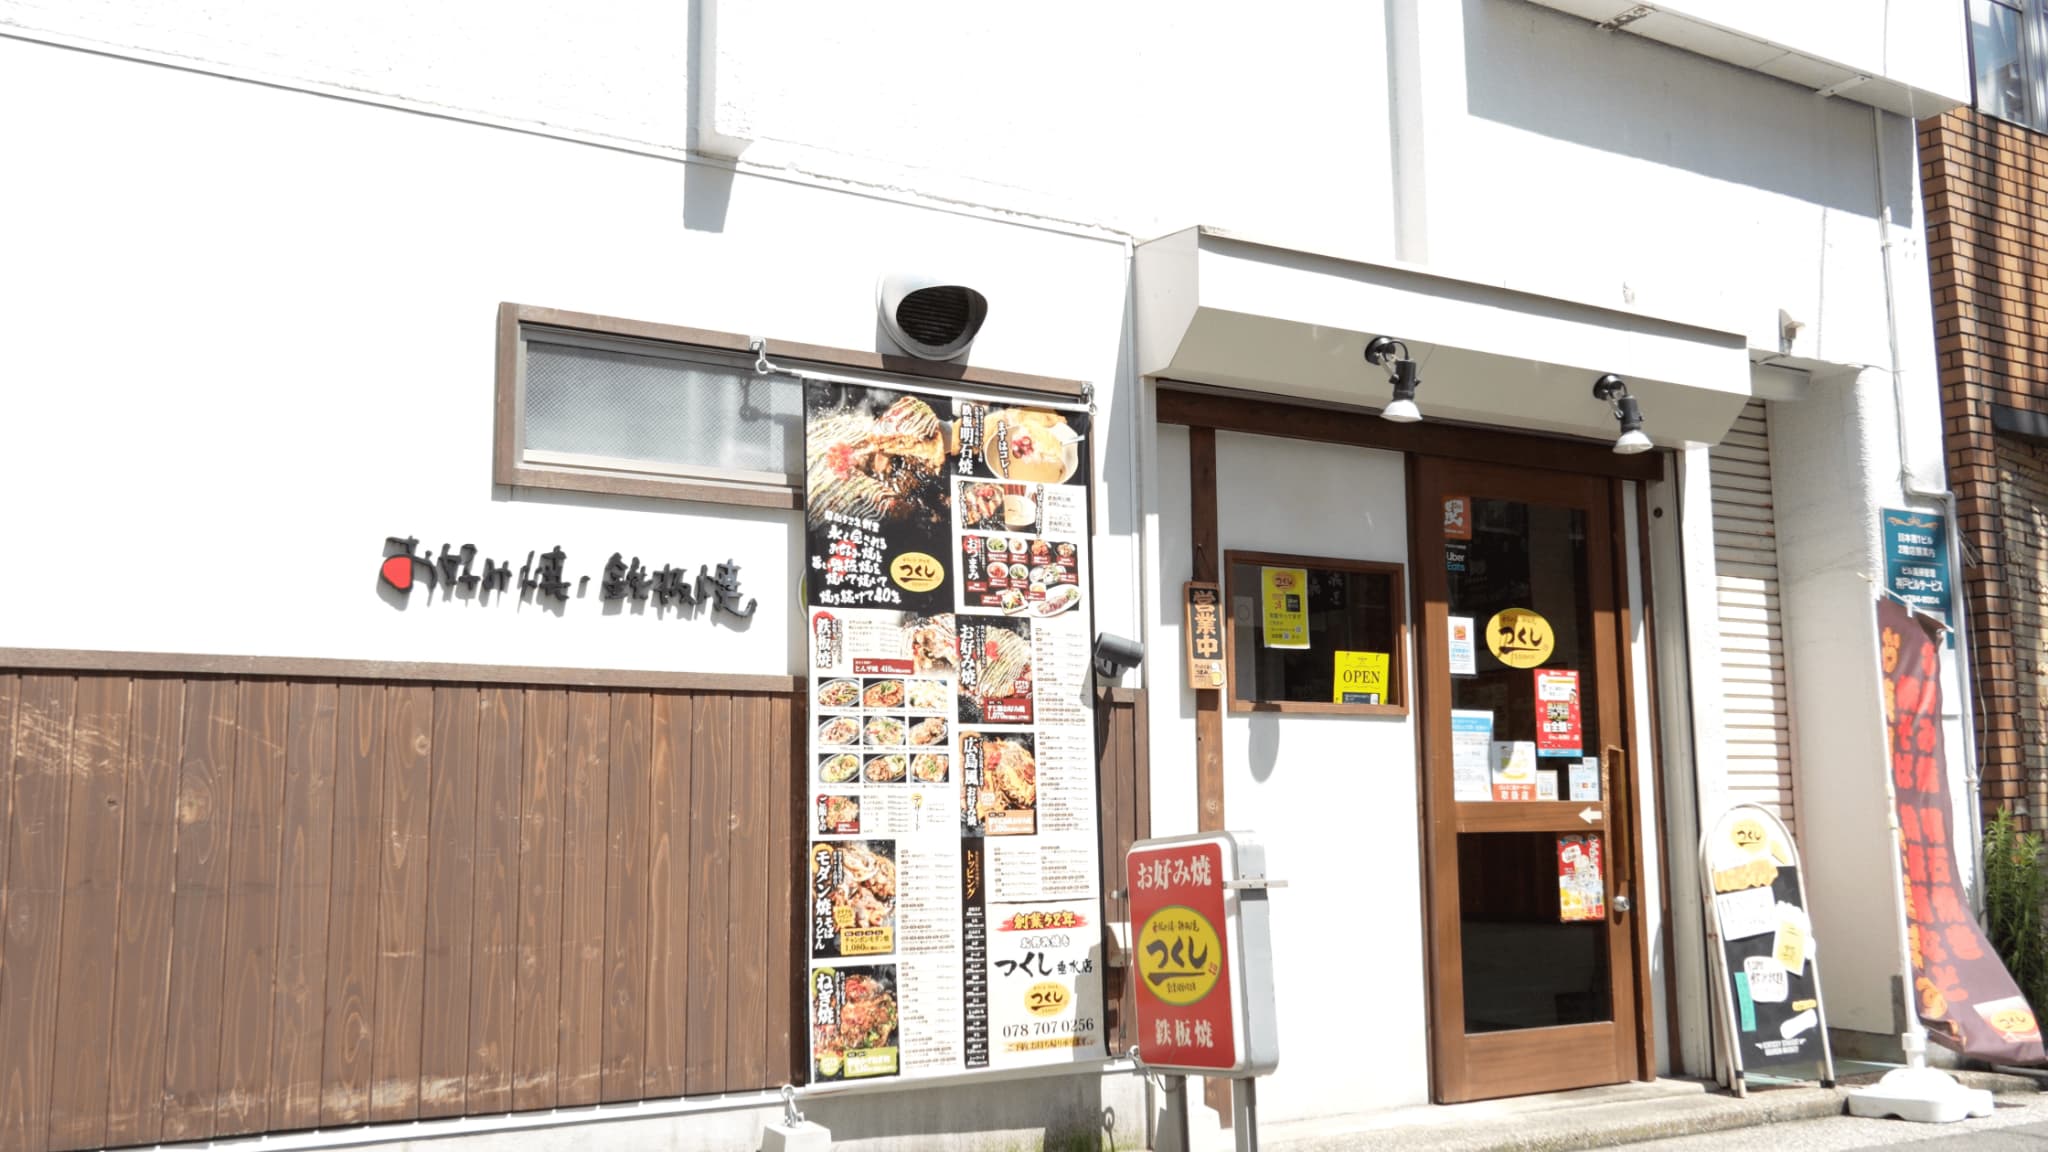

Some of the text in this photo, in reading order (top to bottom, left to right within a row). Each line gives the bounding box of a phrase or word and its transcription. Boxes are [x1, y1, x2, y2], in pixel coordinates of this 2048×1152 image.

[900, 564, 935, 577] つくし
[967, 538, 980, 580] おつまみ
[1446, 552, 1465, 562] Uber
[1193, 590, 1219, 658] 営業中
[1499, 626, 1543, 647] つくし
[816, 618, 832, 668] 鉄板焼
[960, 625, 976, 685] お好み焼
[1343, 669, 1380, 684] OPEN
[816, 851, 832, 916] モダン焼
[966, 850, 976, 900] トッピング
[1137, 855, 1212, 890] お好み焼
[994, 951, 1053, 978] つくし
[1146, 935, 1208, 970] つくし
[817, 974, 834, 1024] ねぎ焼
[1031, 992, 1064, 1004] つくし
[1002, 1017, 1095, 1038] 078 707 0256
[1155, 1018, 1214, 1049] 鉄板焼
